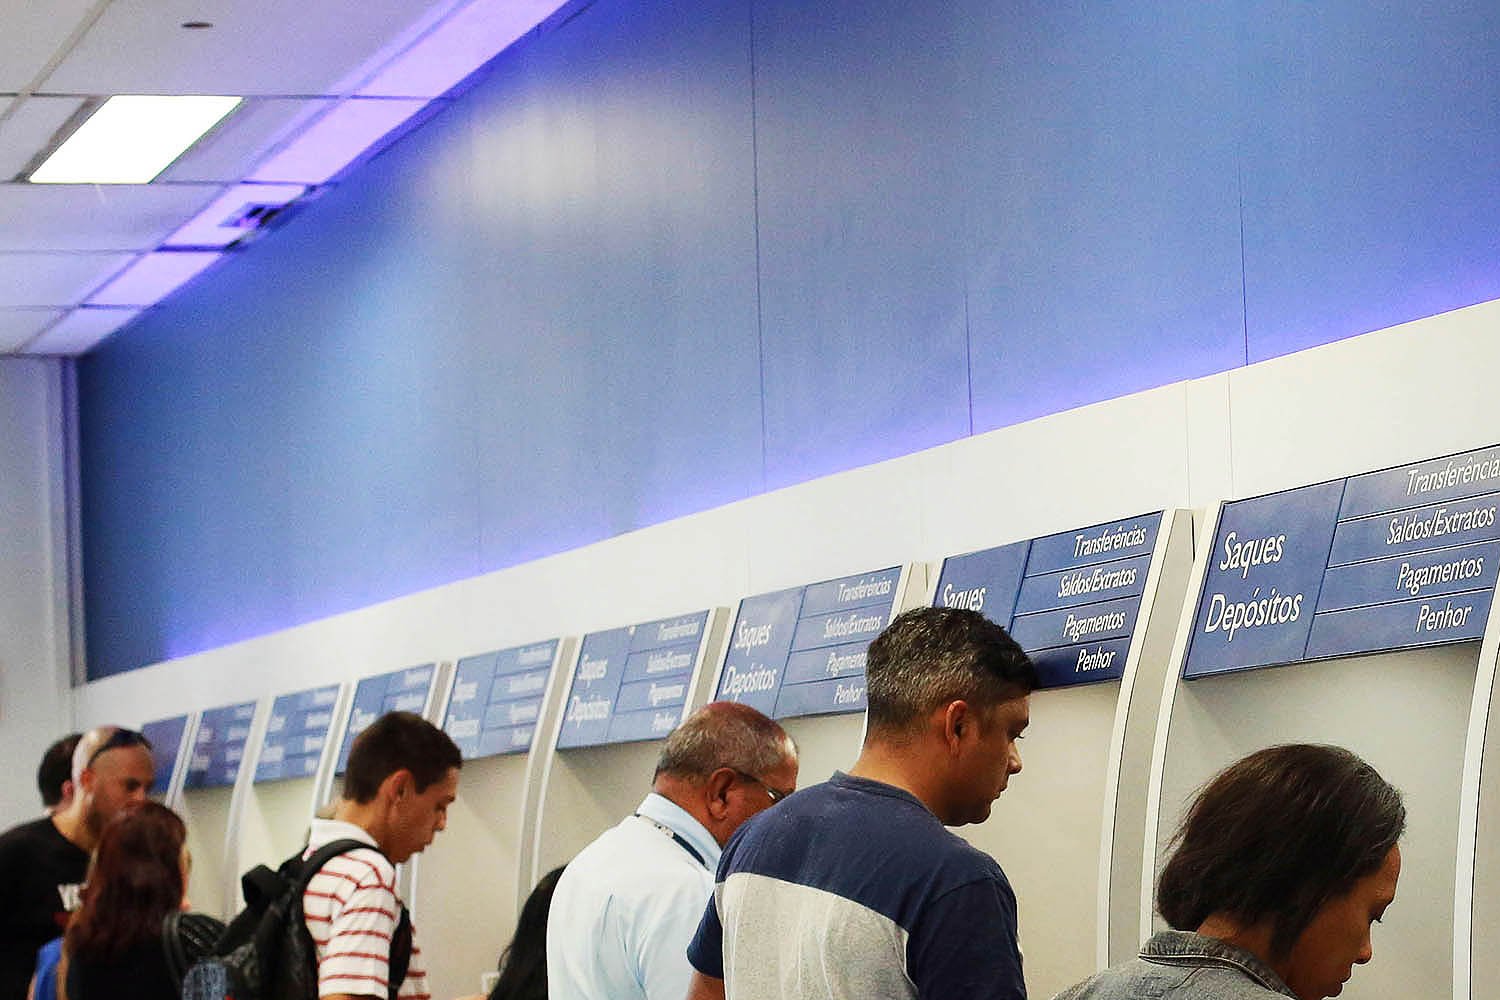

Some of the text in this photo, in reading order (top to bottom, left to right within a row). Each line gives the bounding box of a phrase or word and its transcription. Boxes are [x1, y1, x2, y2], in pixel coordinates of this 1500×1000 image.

[1386, 503, 1497, 545] Saldos/Extratos
[1073, 525, 1147, 558] Transferências
[1219, 531, 1286, 579] Saques
[1057, 566, 1137, 598] Saldos/Extratos
[1396, 556, 1484, 596] Pagamentos
[1063, 612, 1125, 642] Pagamentos
[1204, 587, 1303, 642] Depósitos
[1415, 603, 1472, 633] Penhor
[1075, 645, 1116, 673] Penhor
